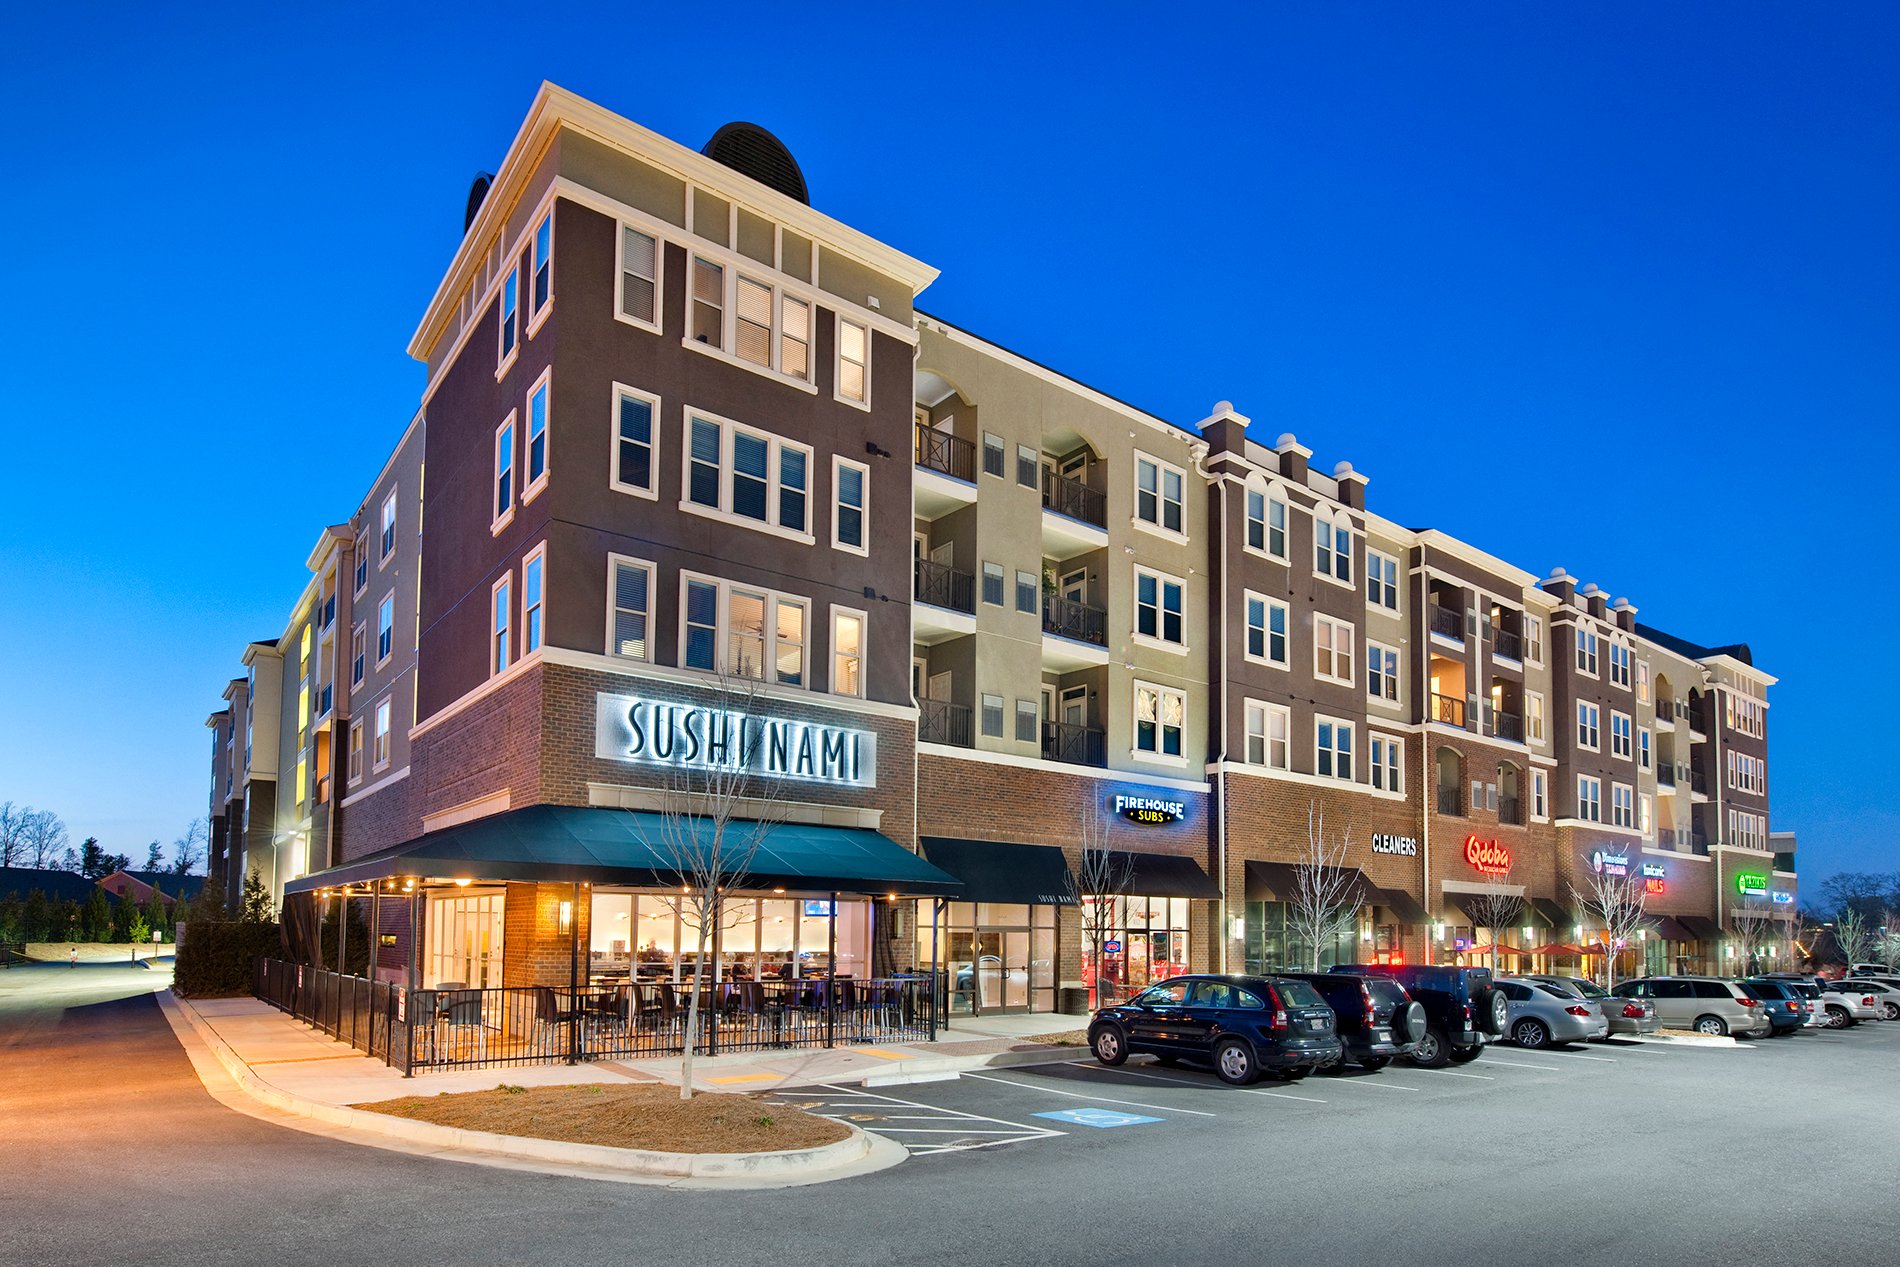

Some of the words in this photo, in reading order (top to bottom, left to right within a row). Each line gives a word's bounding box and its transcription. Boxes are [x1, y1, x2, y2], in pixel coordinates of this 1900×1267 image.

[628, 701, 747, 767] SUSHI
[768, 722, 859, 781] NAMI
[1115, 795, 1184, 820] FIREHOUSE
[1138, 810, 1164, 823] SUBS
[1372, 833, 1417, 857] CLEANERS
[1466, 834, 1509, 871] Qdoba
[1646, 878, 1664, 893] NAILS
